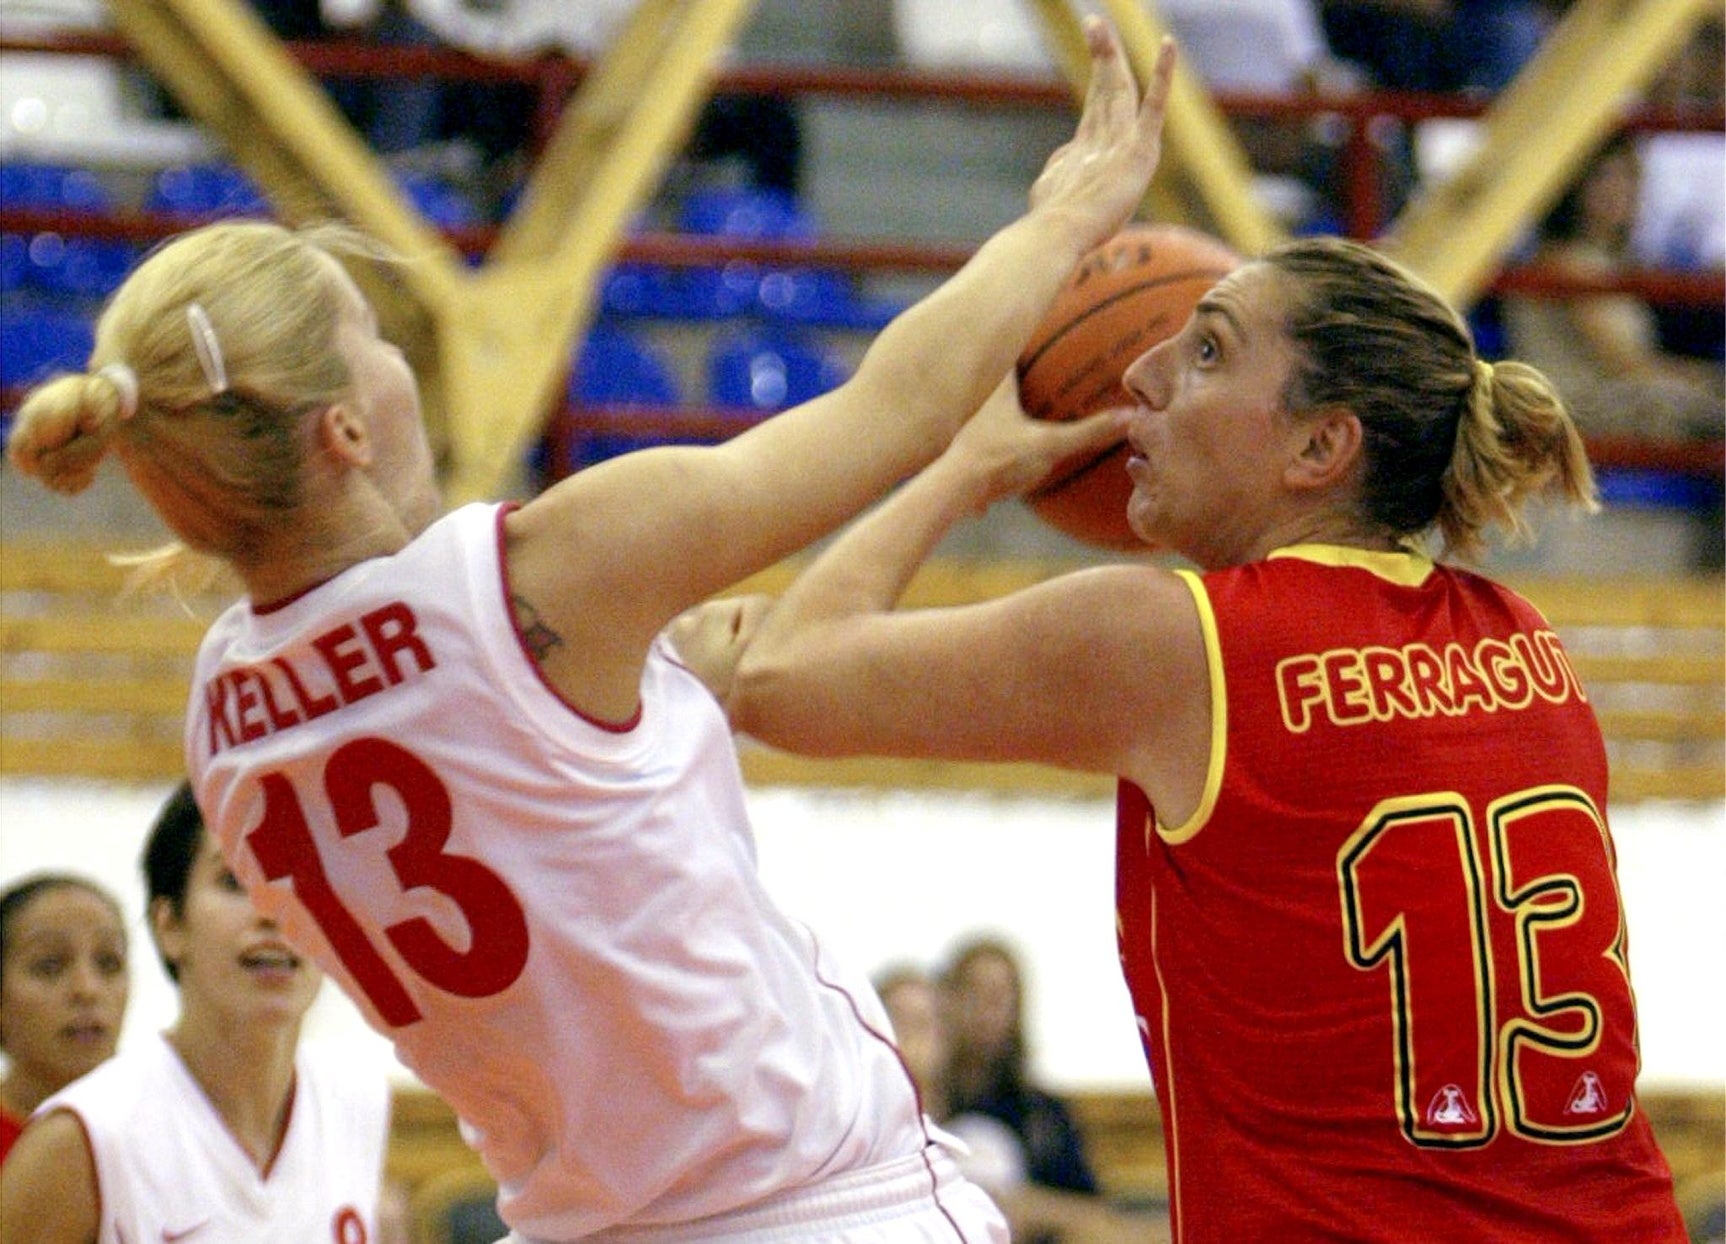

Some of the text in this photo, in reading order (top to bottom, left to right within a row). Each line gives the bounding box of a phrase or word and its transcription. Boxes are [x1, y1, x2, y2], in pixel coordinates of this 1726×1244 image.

[205, 601, 436, 756] KELLER
[246, 736, 530, 1028] 13
[1336, 784, 1642, 1149] 13
